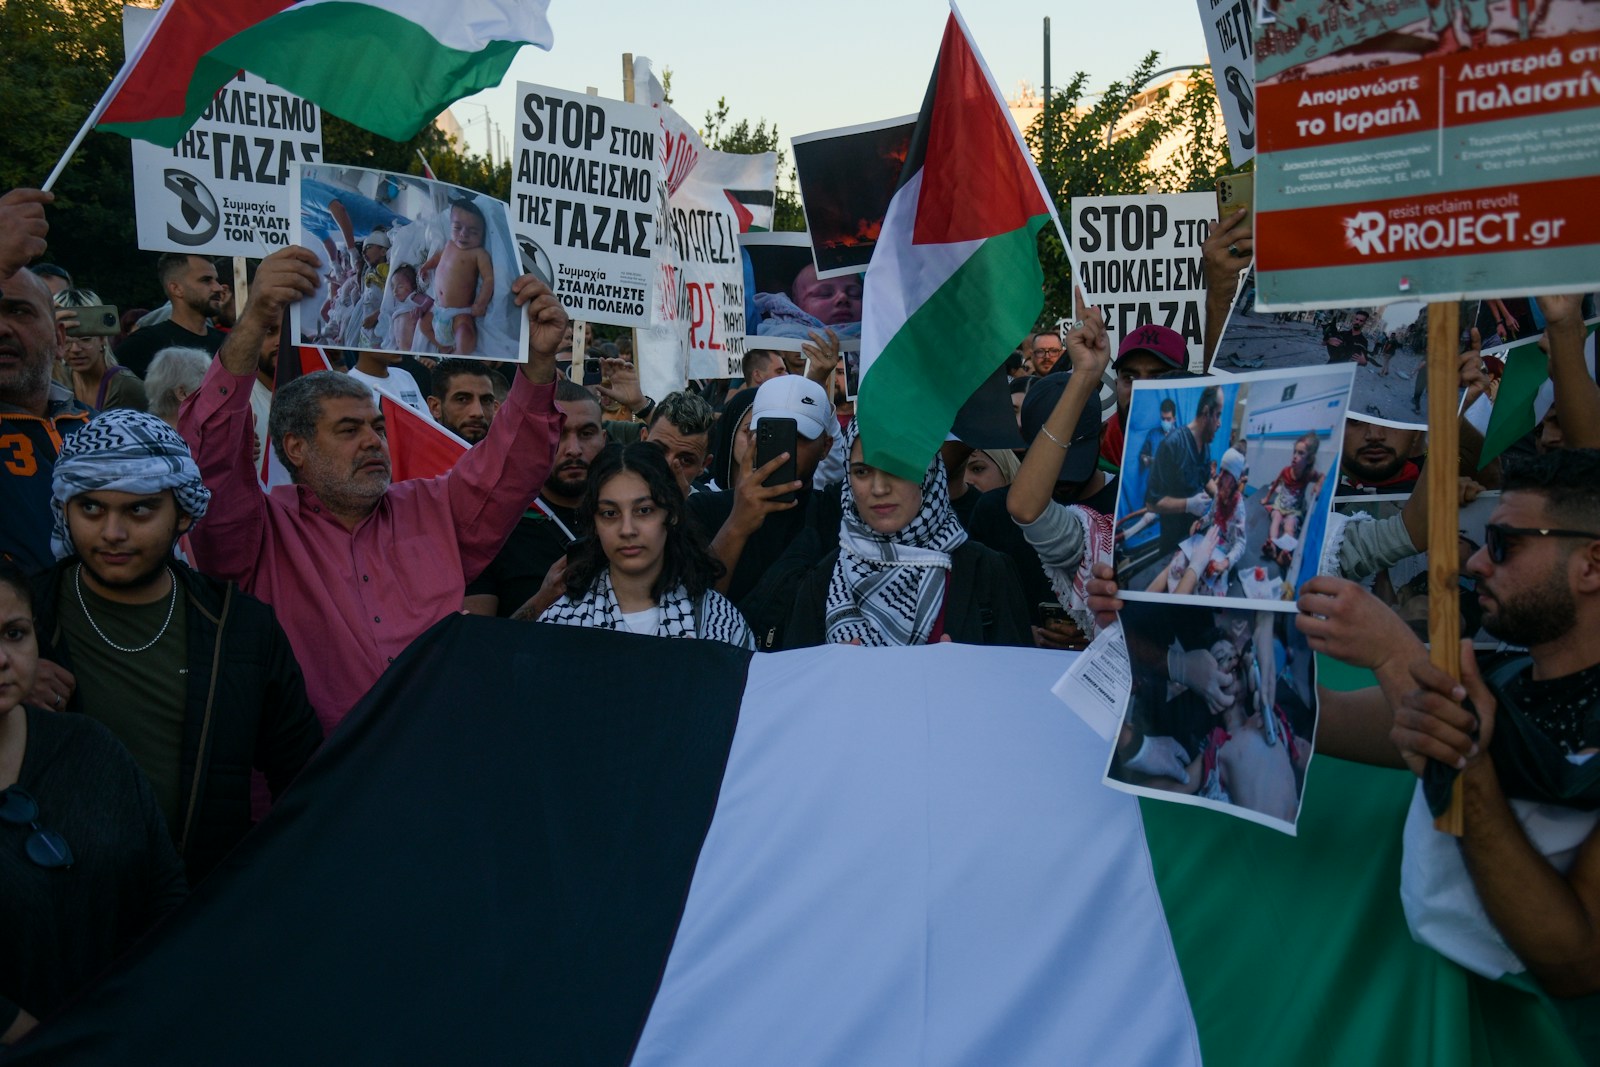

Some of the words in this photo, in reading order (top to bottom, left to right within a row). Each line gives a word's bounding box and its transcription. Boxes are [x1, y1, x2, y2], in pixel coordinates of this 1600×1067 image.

[1216, 10, 1237, 53] ΤΗΣ
[1459, 48, 1562, 81] Λευτεριά
[1570, 46, 1600, 63] στ
[1298, 77, 1419, 107] Απομονώστε
[1456, 70, 1600, 114] Παλαιστίν
[522, 93, 605, 151] STOP
[610, 126, 654, 160] ΣΤΟΝ
[1296, 118, 1326, 136] το
[1334, 98, 1421, 133] Ισραήλ
[517, 148, 651, 203] ΑΠΟΚΛΕΙΣΜΟ
[223, 198, 276, 216] Συμμαχία
[1388, 204, 1420, 219] resist
[1424, 198, 1473, 215] reclaim
[1477, 193, 1518, 210] revolt
[224, 228, 254, 242] ΤΟΝ
[260, 230, 290, 245] ΠΟΛ
[518, 194, 552, 226] ΤΗΣ
[554, 200, 652, 258] ΓΑΖΑΣ
[1079, 205, 1168, 252] STOP
[1174, 219, 1218, 248] ΣΤΟ
[557, 279, 644, 301] ΣΤΑΜΑΤΗΣΤΕ
[558, 263, 606, 280] Συμμαχία
[1080, 258, 1206, 294] ΑΠΟΚΛΕΙΣΜ
[557, 294, 583, 308] ΤΟΝ
[589, 297, 644, 316] ΠΟΛΕΜΟ
[1119, 301, 1202, 344] ΓΑΖΑ
[0, 433, 38, 476] 3
